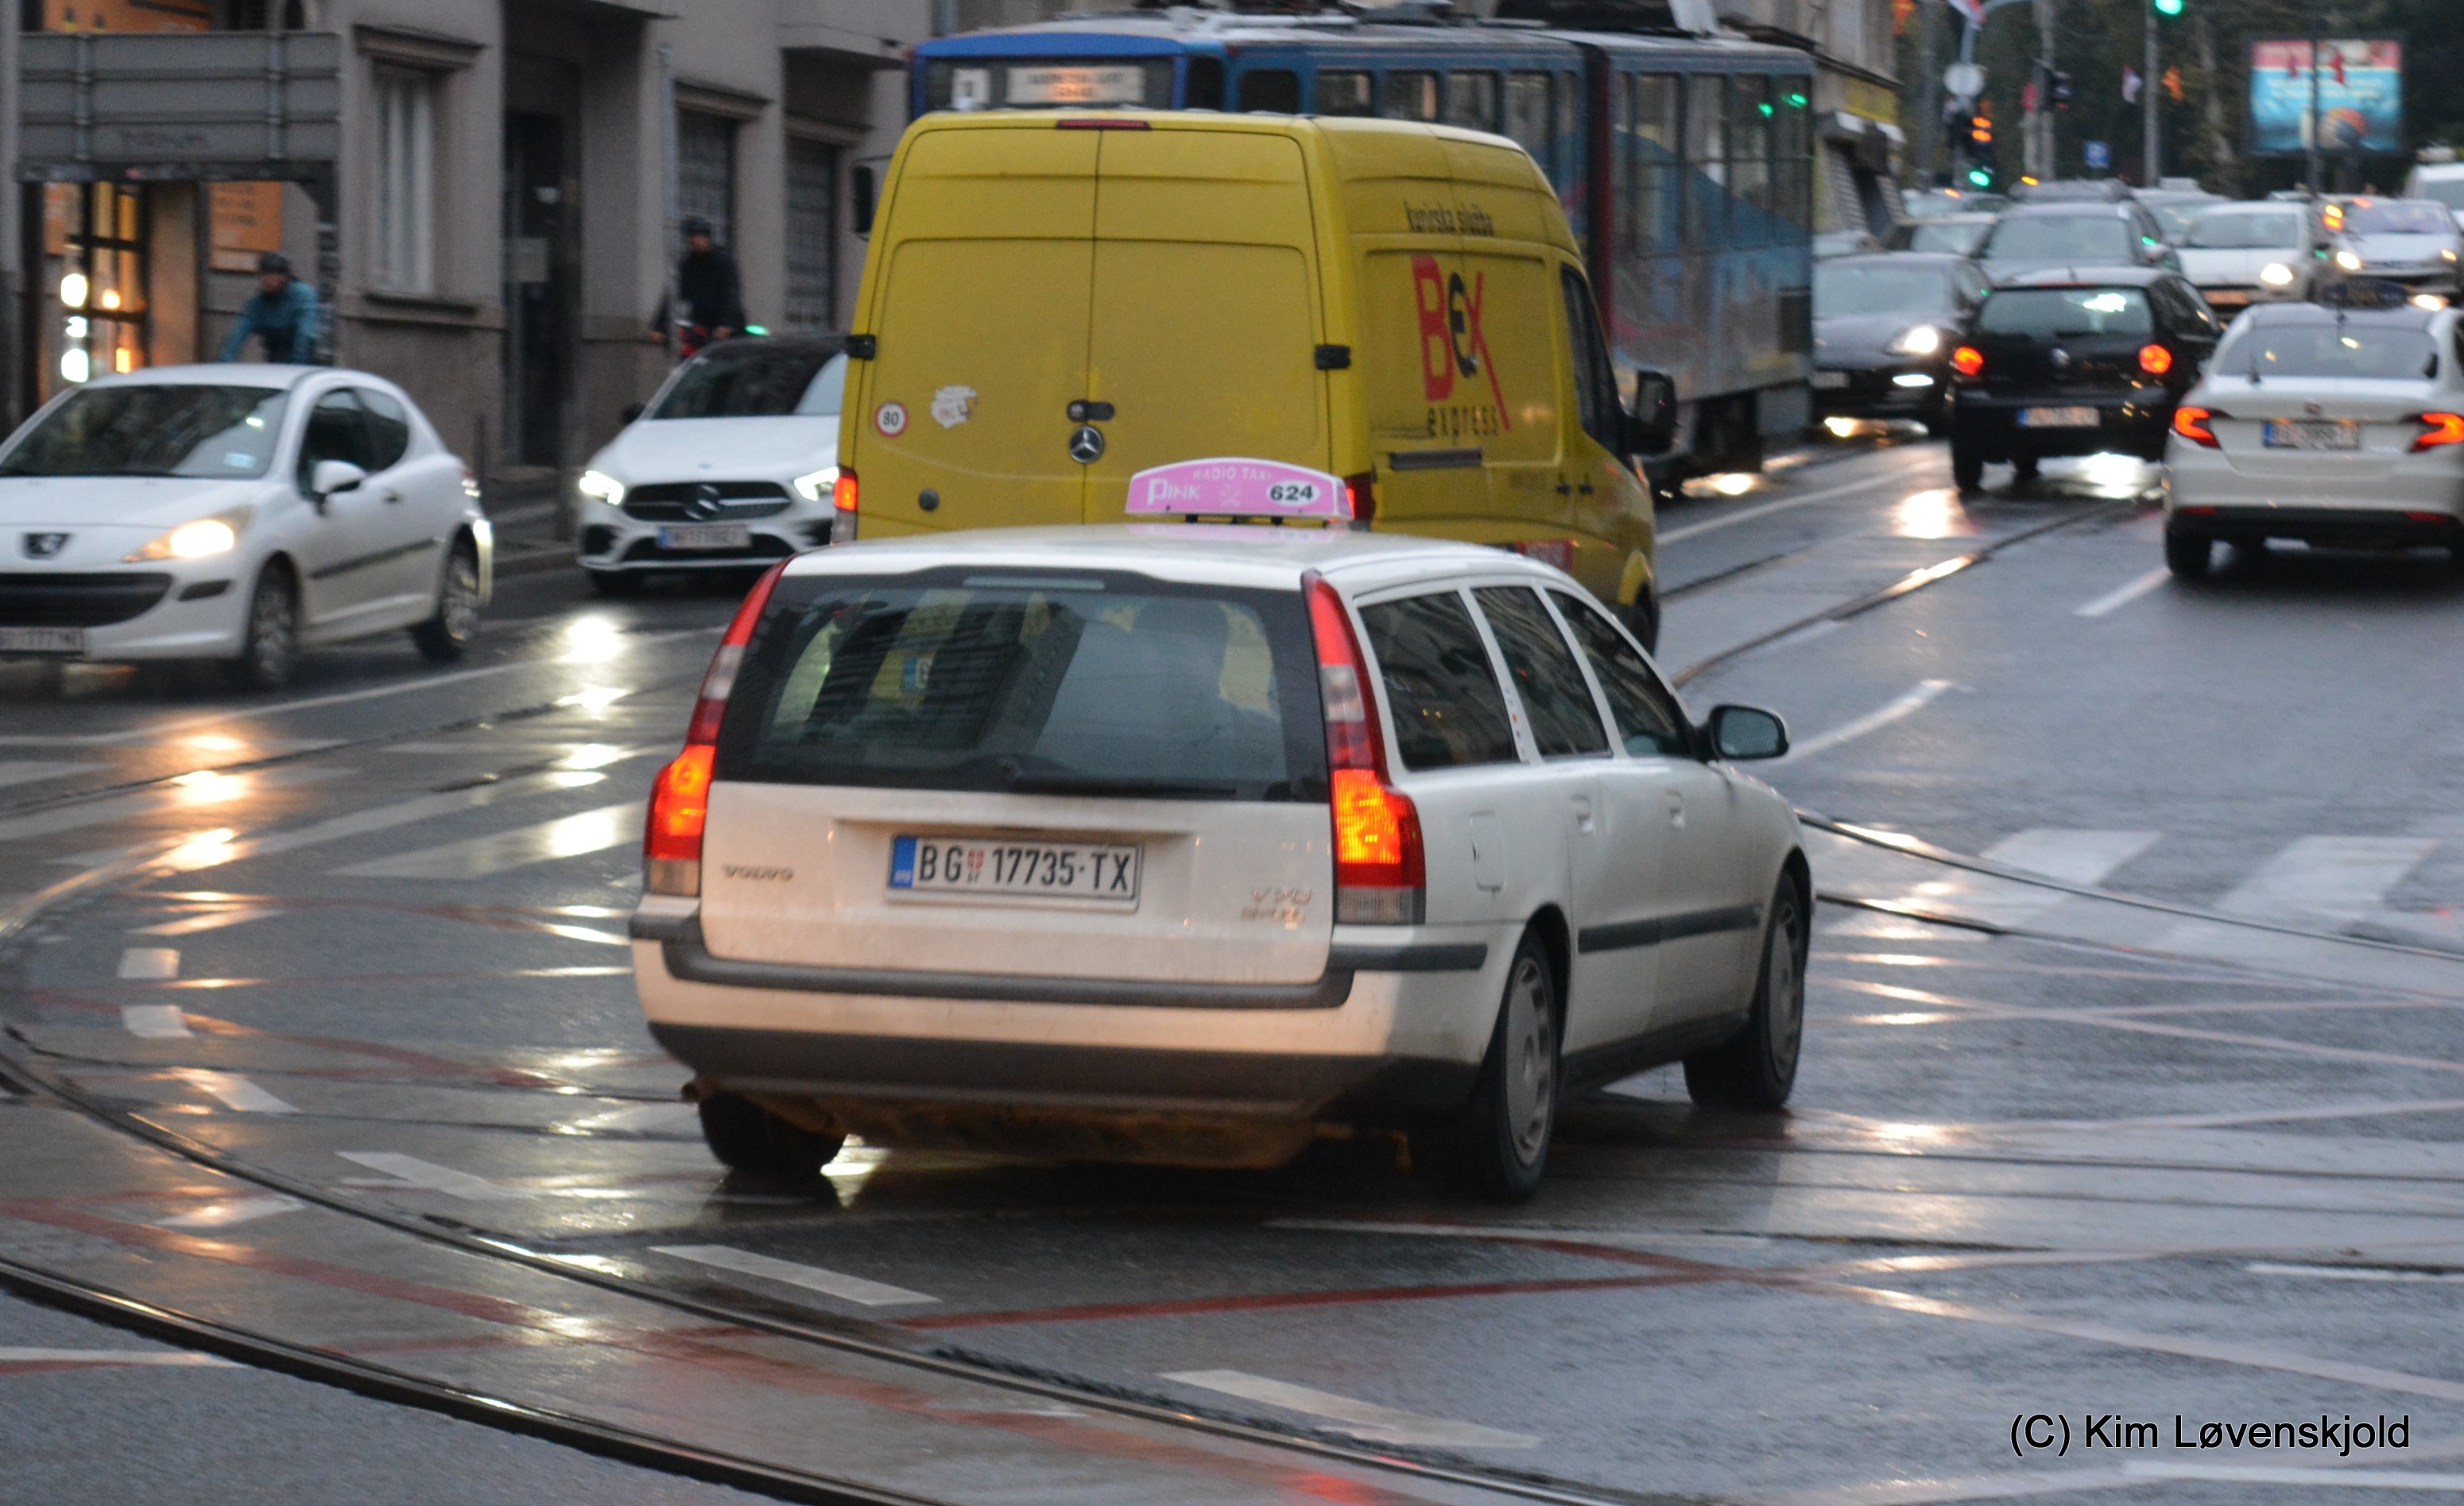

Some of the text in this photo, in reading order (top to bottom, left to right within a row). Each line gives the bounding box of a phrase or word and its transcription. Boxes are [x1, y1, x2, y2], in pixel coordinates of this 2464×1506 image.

[881, 411, 900, 426] 80
[1194, 467, 1236, 481] RADIO
[1270, 486, 1313, 501] 624
[918, 845, 963, 882] BG
